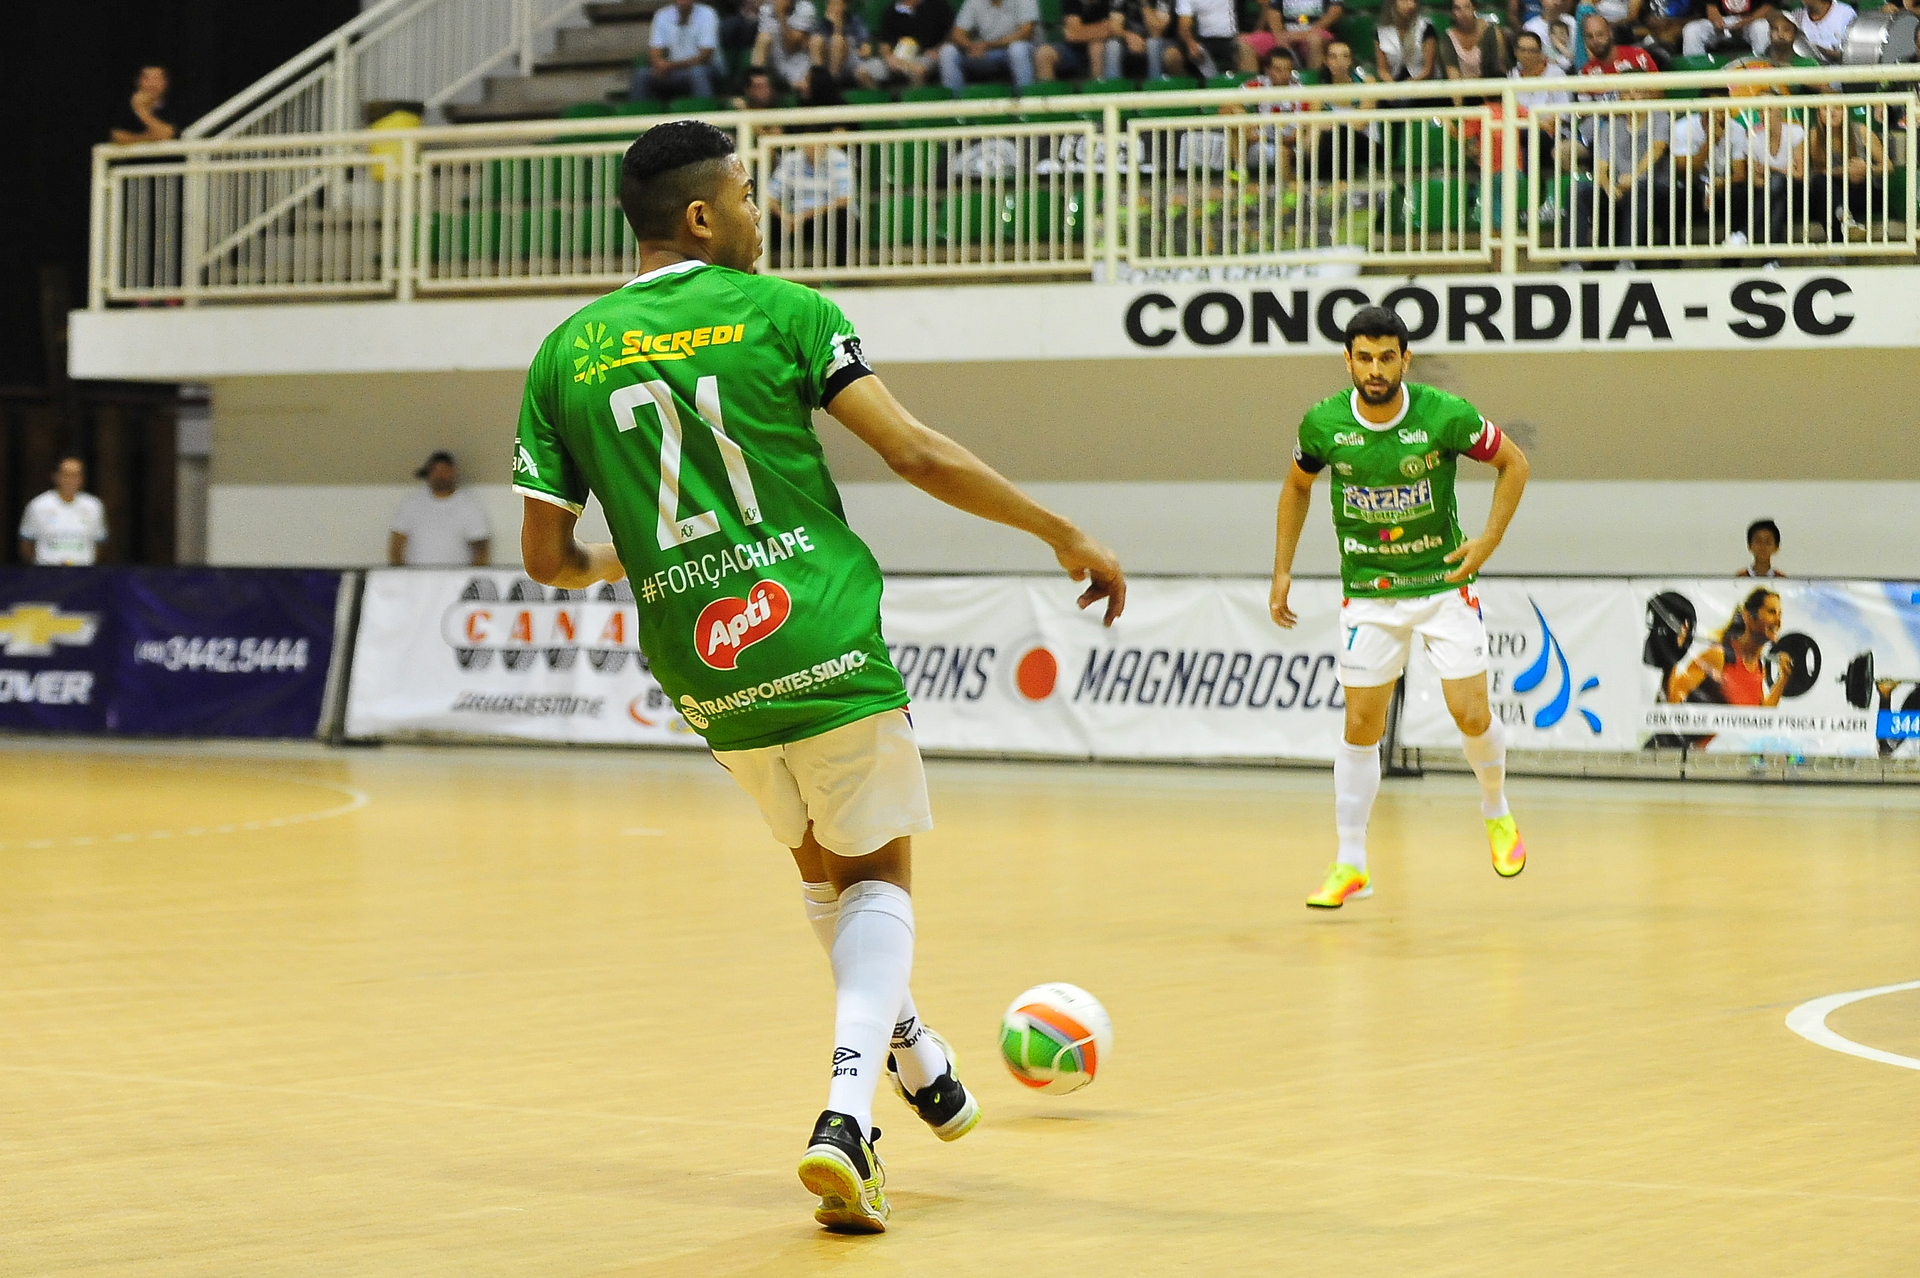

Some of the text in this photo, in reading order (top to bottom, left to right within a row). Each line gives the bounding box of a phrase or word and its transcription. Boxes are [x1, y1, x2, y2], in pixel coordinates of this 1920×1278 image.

[1727, 277, 1855, 339] SC
[621, 323, 745, 356] SICREDI
[609, 374, 763, 551] 21
[641, 527, 815, 604] #FORÇACHAPE
[708, 589, 772, 656] Apti
[1347, 626, 1359, 651] 7
[700, 668, 813, 716] TRANSPORTES
